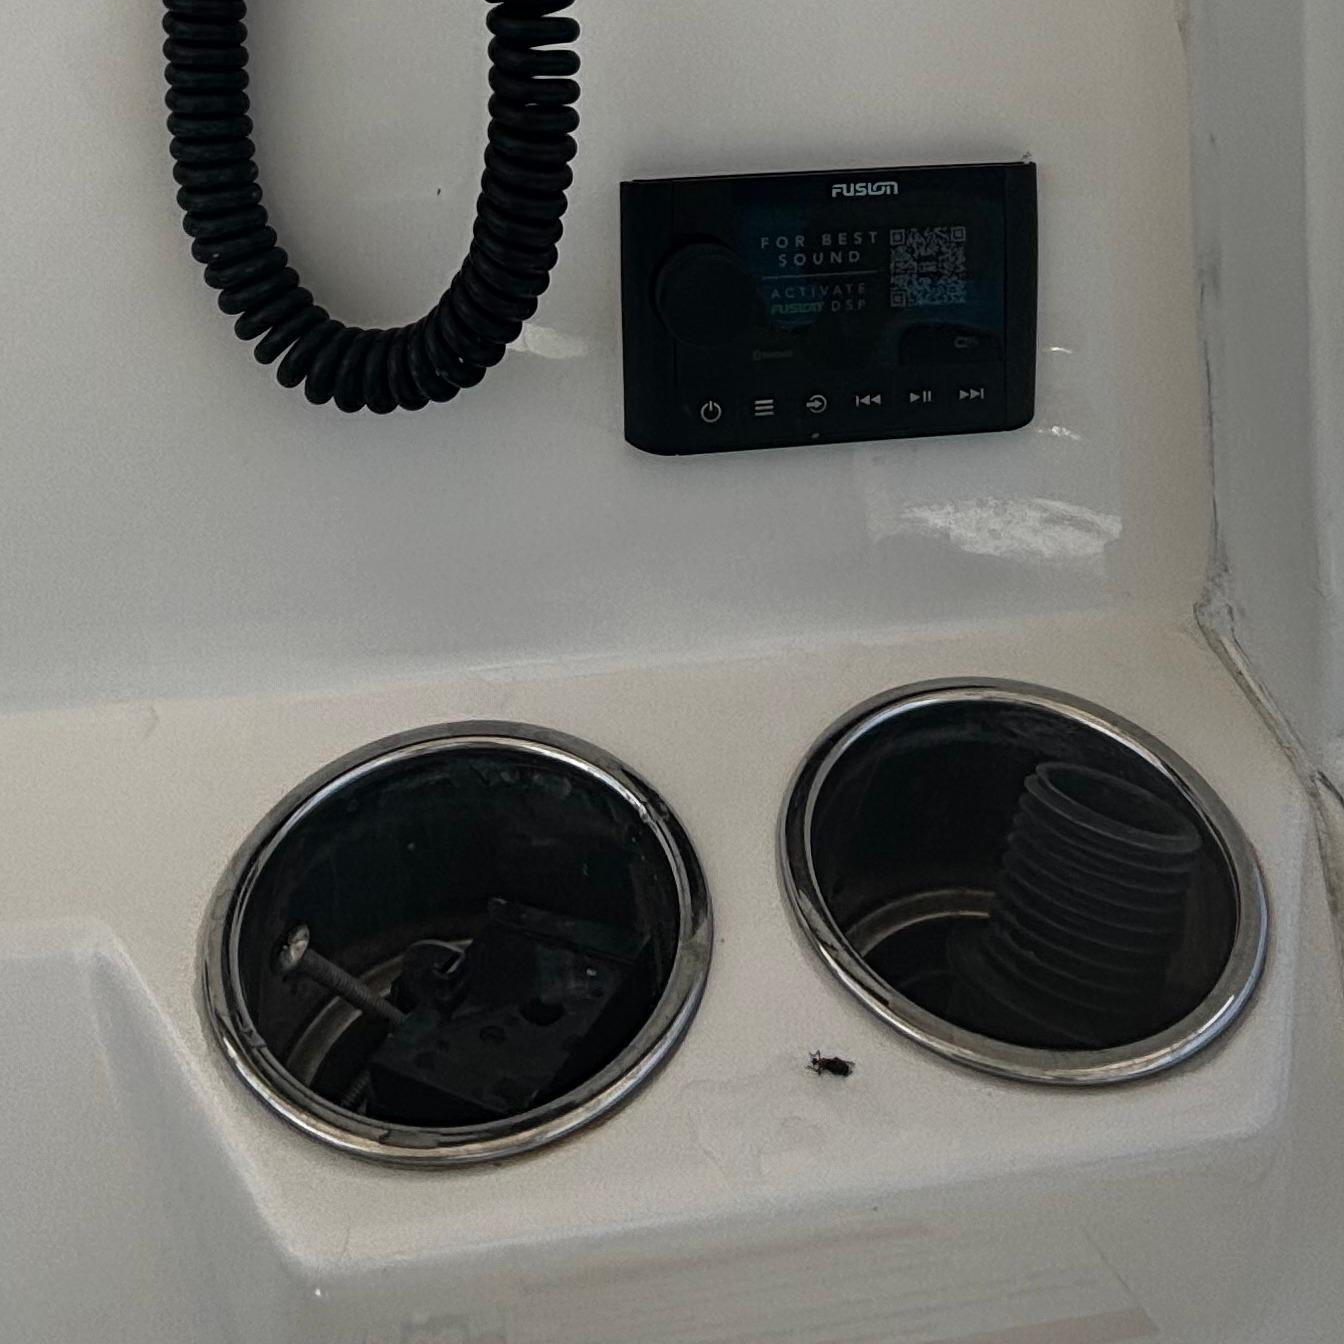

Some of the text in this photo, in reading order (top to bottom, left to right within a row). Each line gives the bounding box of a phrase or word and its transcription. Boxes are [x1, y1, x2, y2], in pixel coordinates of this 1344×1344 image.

[832, 180, 899, 198] FUSION
[760, 231, 879, 249] FOR BEST
[778, 250, 861, 268] SOUND
[771, 283, 865, 299] ACTIVATE
[831, 299, 866, 313] DSP
